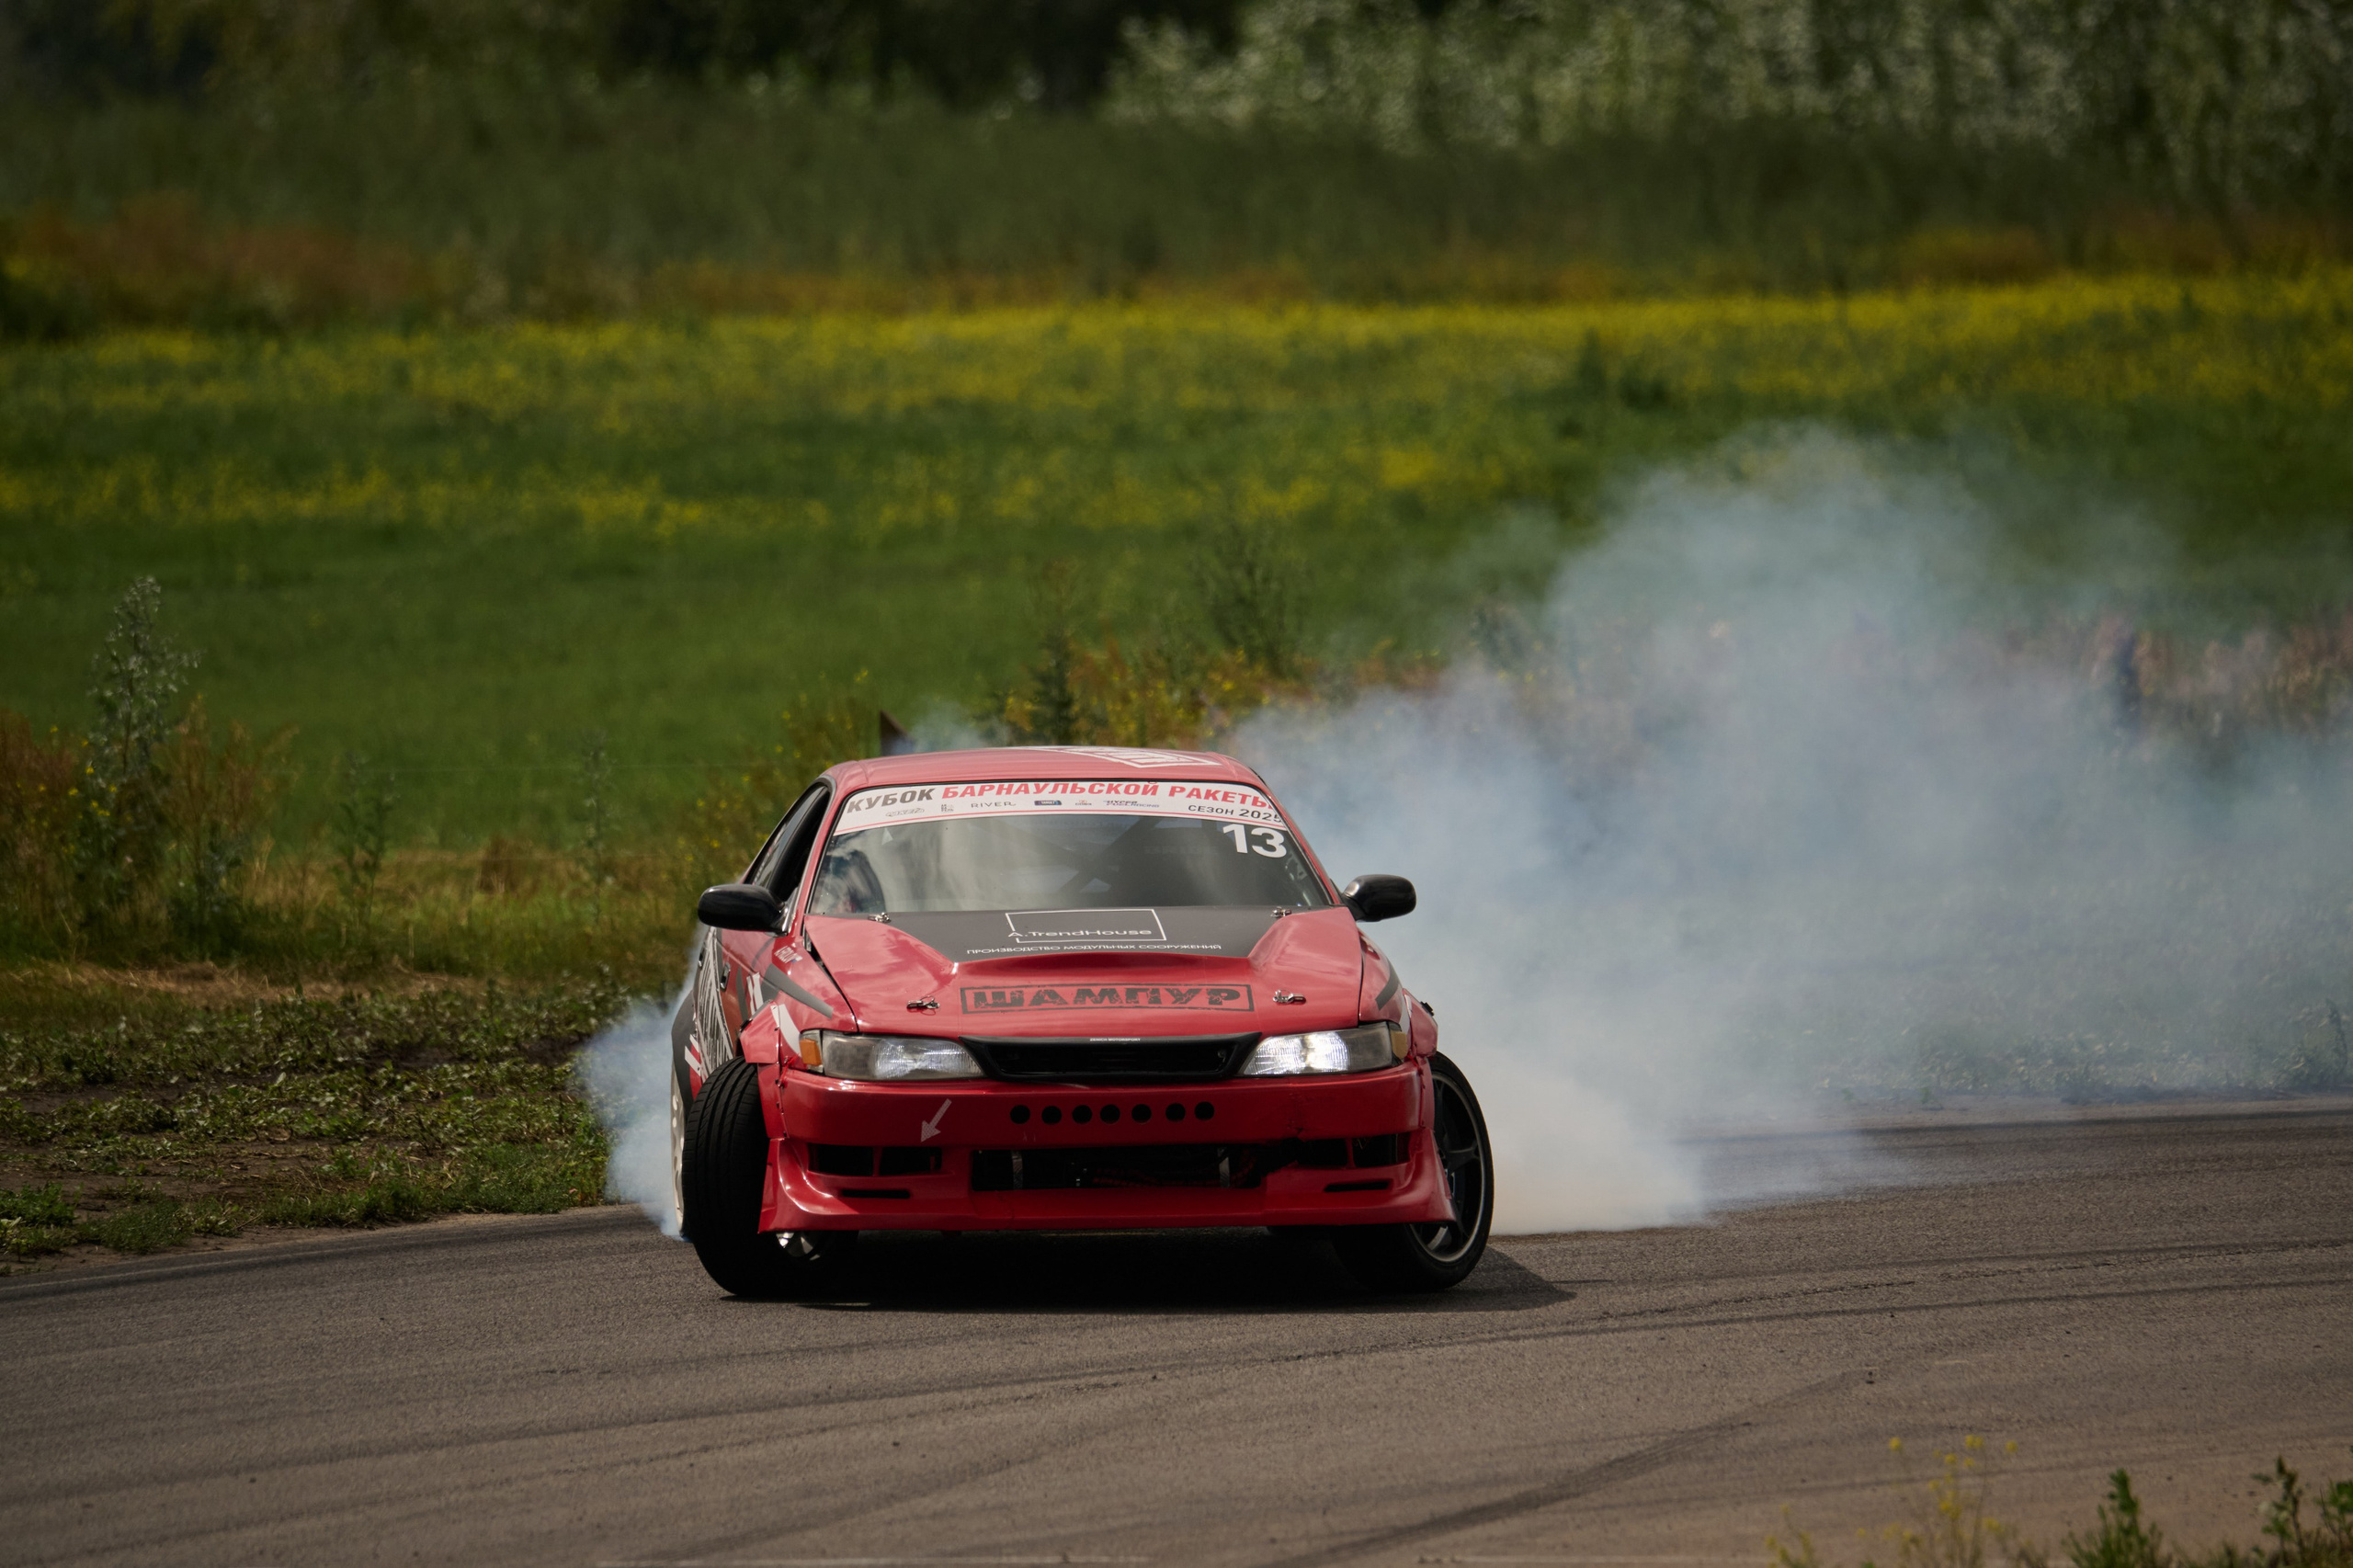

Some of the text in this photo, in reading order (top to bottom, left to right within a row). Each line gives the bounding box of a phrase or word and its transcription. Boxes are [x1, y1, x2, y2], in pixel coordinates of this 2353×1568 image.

[847, 788, 936, 814] КУБОК
[941, 781, 1159, 800] БАРНАУЛЬСКОЙ
[971, 801, 1016, 809] RIVER
[1188, 804, 1282, 824] СЕЗОН 2025
[1222, 824, 1287, 858] 13
[1007, 929, 1153, 937] A.TrendHouse
[966, 945, 1061, 955] ПРОИЗВОДСТВО
[972, 987, 1241, 1008] ШАМПУР
